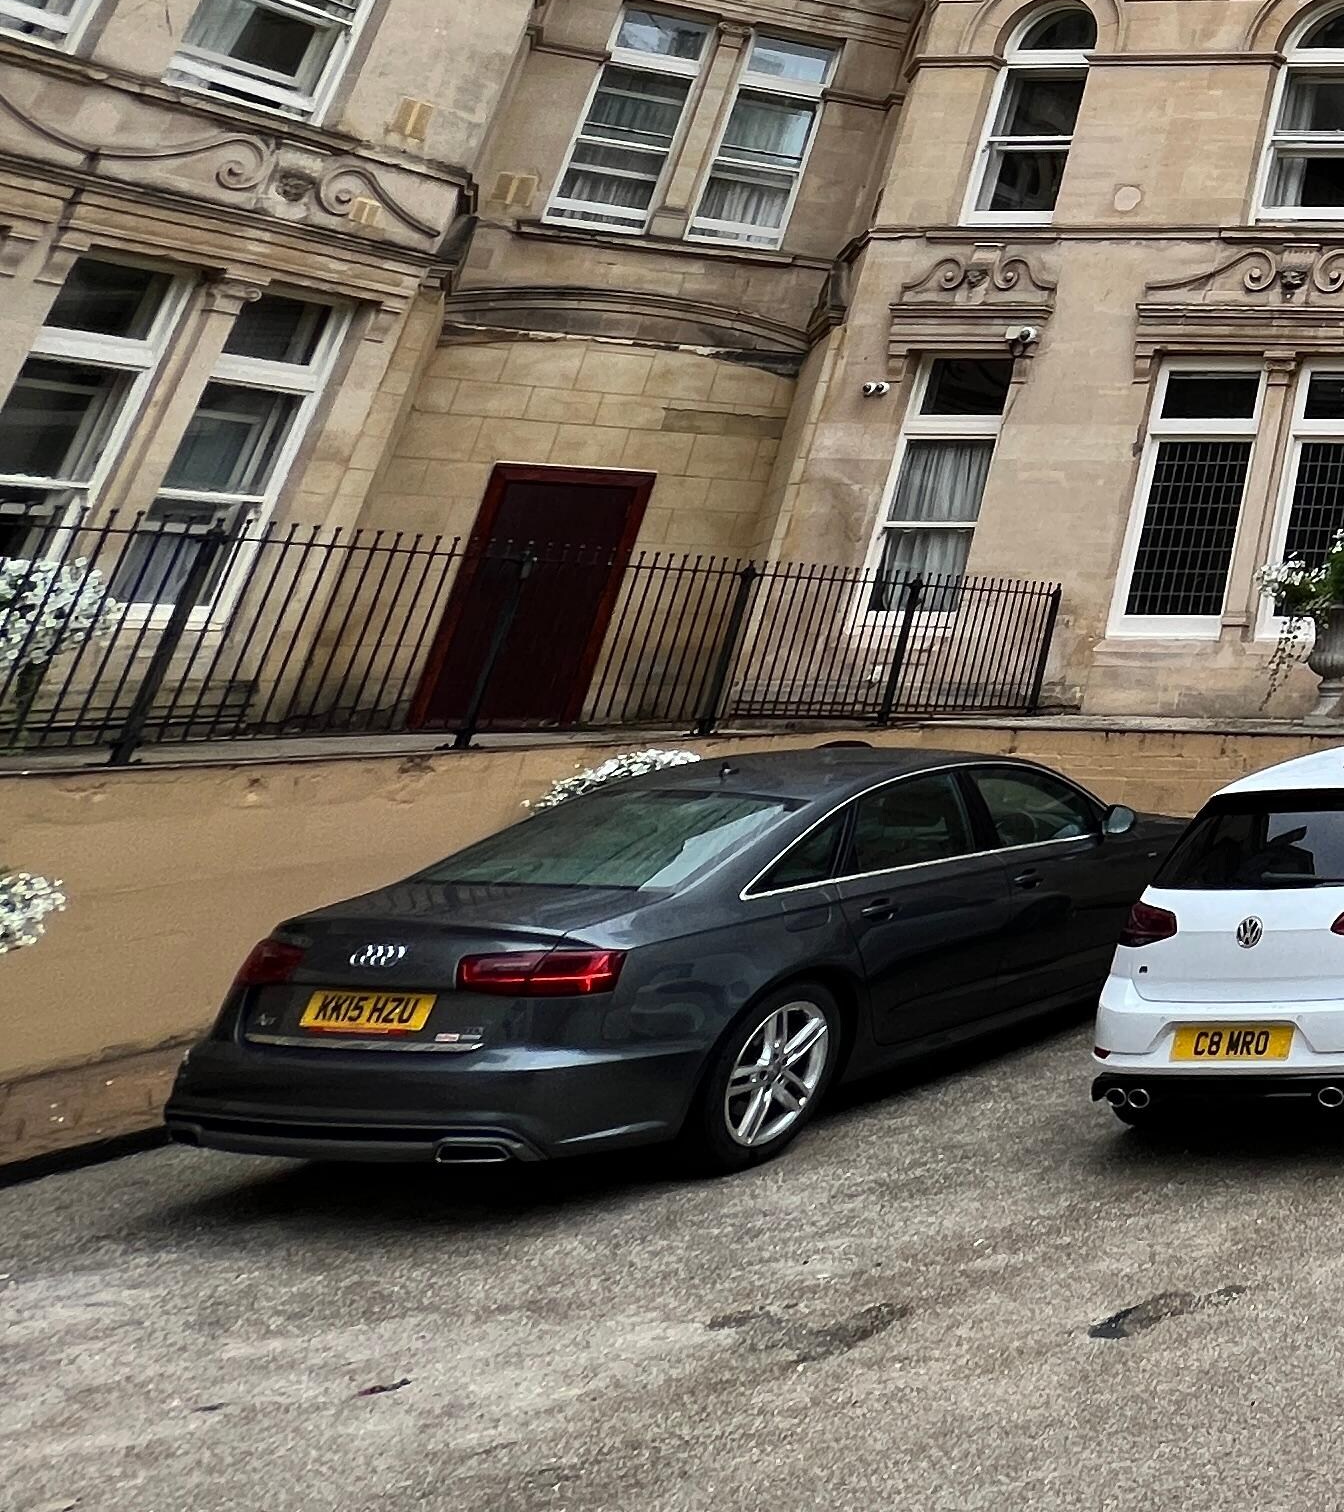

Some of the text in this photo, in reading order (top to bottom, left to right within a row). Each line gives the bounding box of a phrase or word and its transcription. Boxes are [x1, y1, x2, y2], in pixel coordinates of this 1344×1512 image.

[314, 994, 421, 1024] KK15 HZU
[1193, 1031, 1270, 1056] C8 MRO
